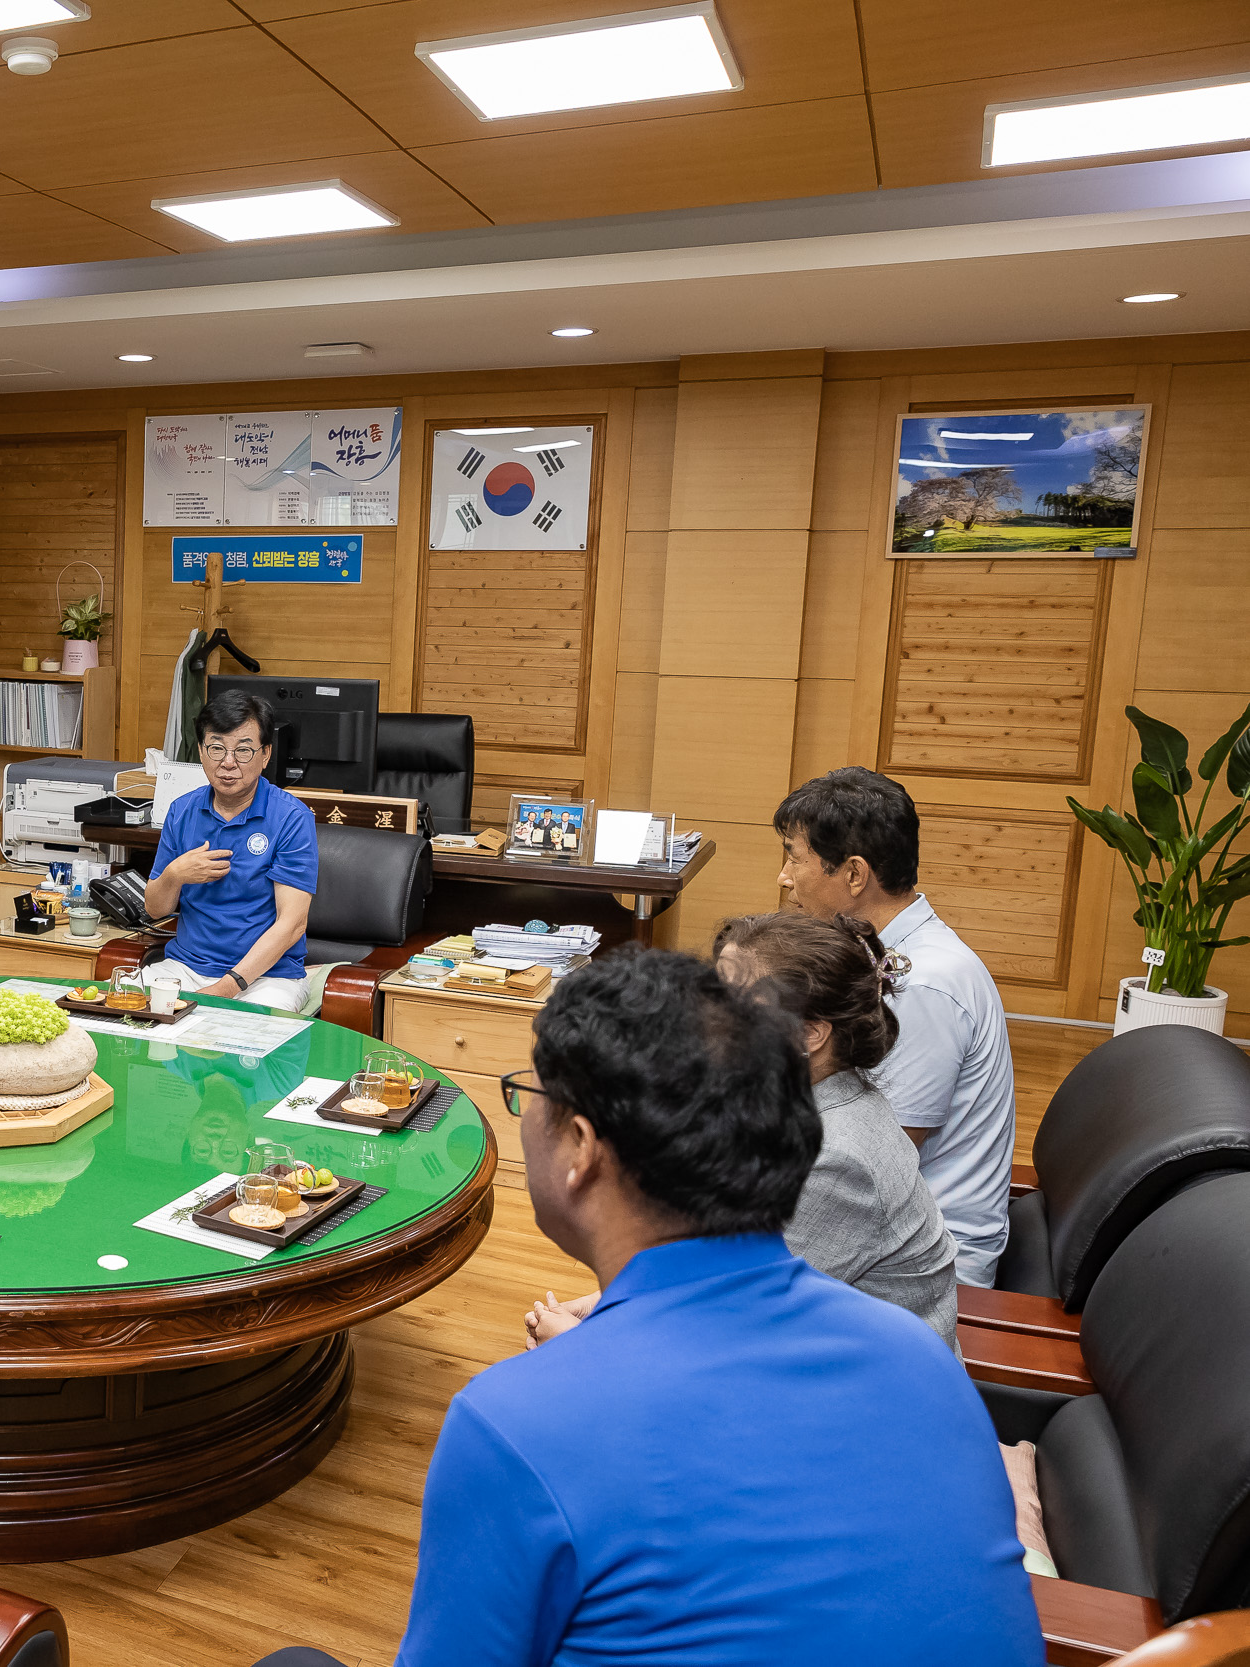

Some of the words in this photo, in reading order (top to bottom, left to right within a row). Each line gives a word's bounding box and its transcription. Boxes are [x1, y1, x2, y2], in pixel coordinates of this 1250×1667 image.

[234, 430, 274, 452] 대도약!
[250, 444, 269, 455] 전남
[335, 440, 382, 466] 장흥
[226, 551, 249, 568] 청렴,
[252, 551, 295, 567] 신뢰받는
[297, 550, 320, 567] 장흥
[290, 690, 303, 699] LG
[163, 772, 172, 781] 07
